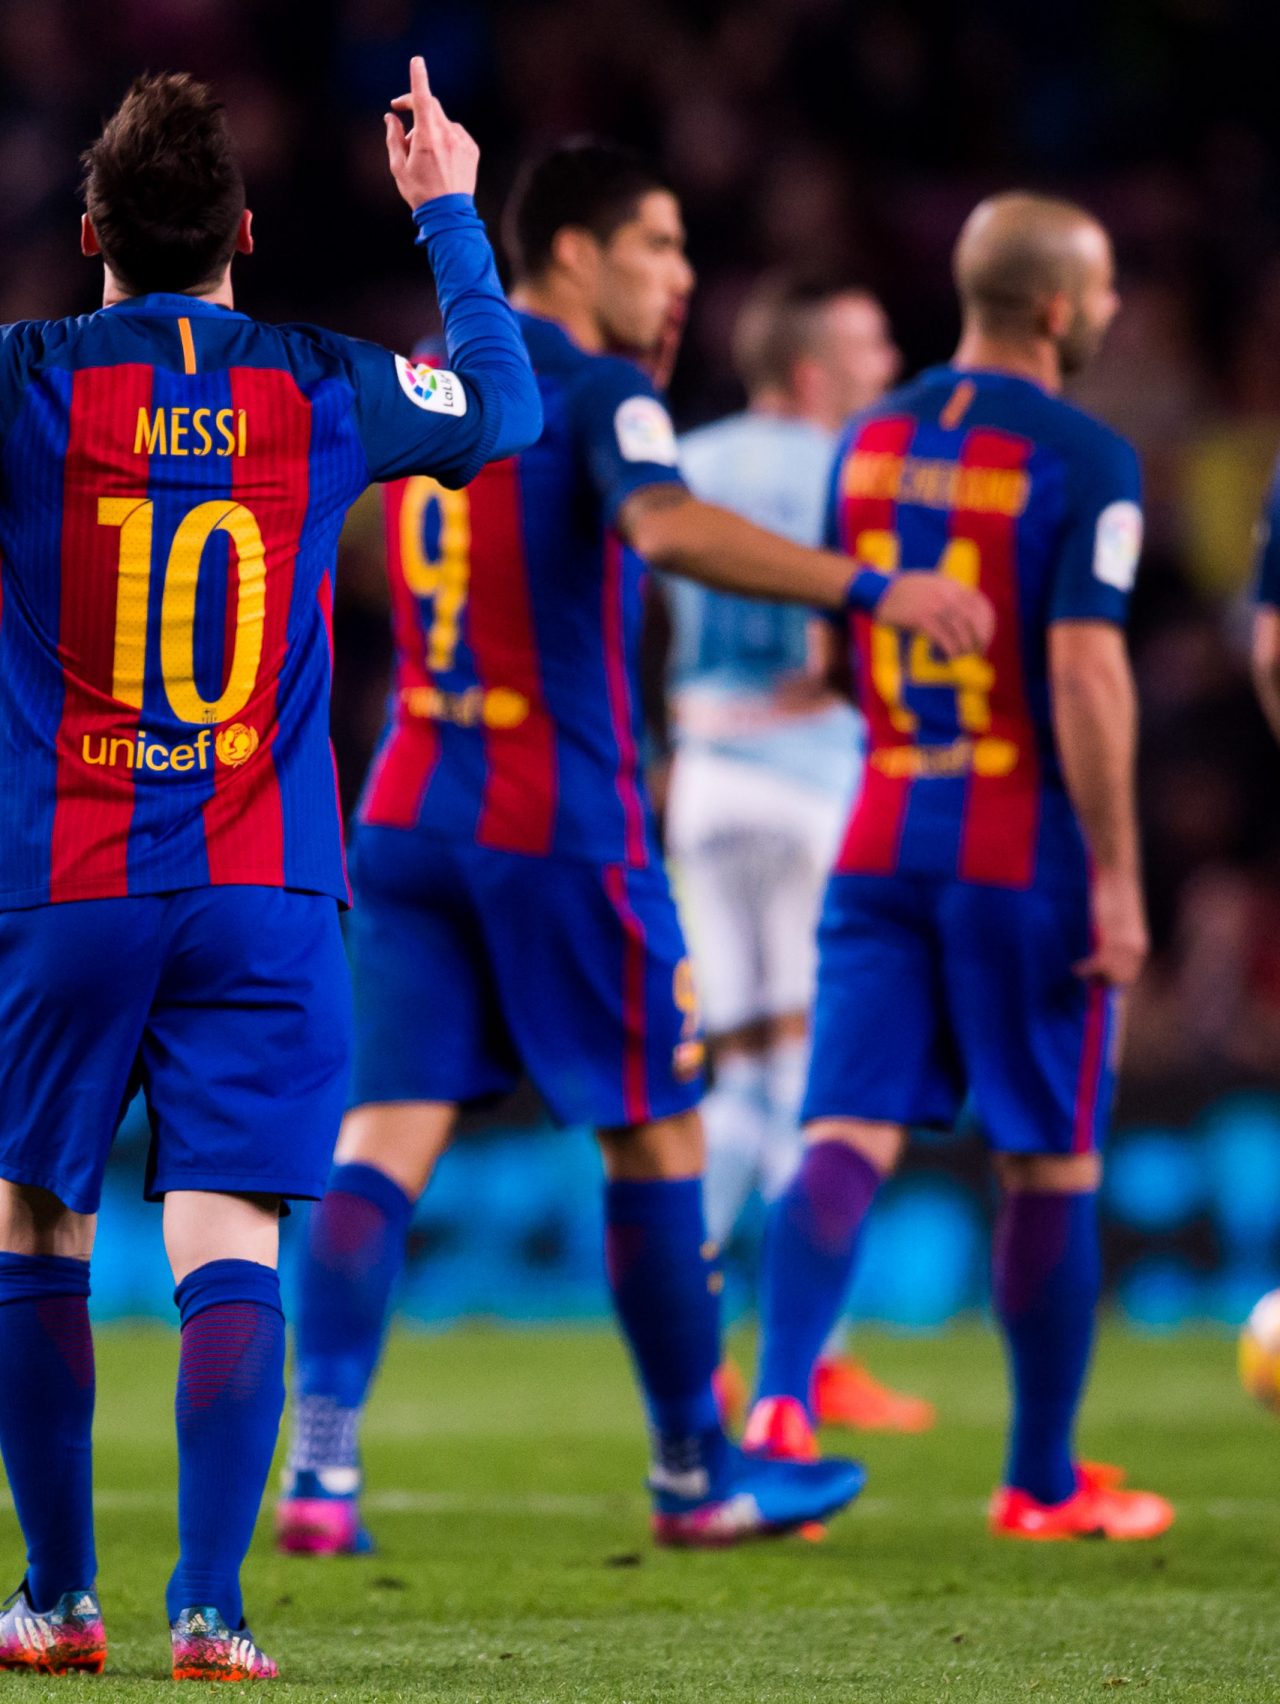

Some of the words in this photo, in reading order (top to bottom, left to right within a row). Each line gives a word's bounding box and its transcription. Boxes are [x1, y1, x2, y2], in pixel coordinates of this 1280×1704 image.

[133, 407, 247, 458] MESSI
[97, 496, 267, 725] 10
[398, 474, 472, 673] 9
[855, 528, 996, 734] 14
[81, 730, 211, 772] unicef
